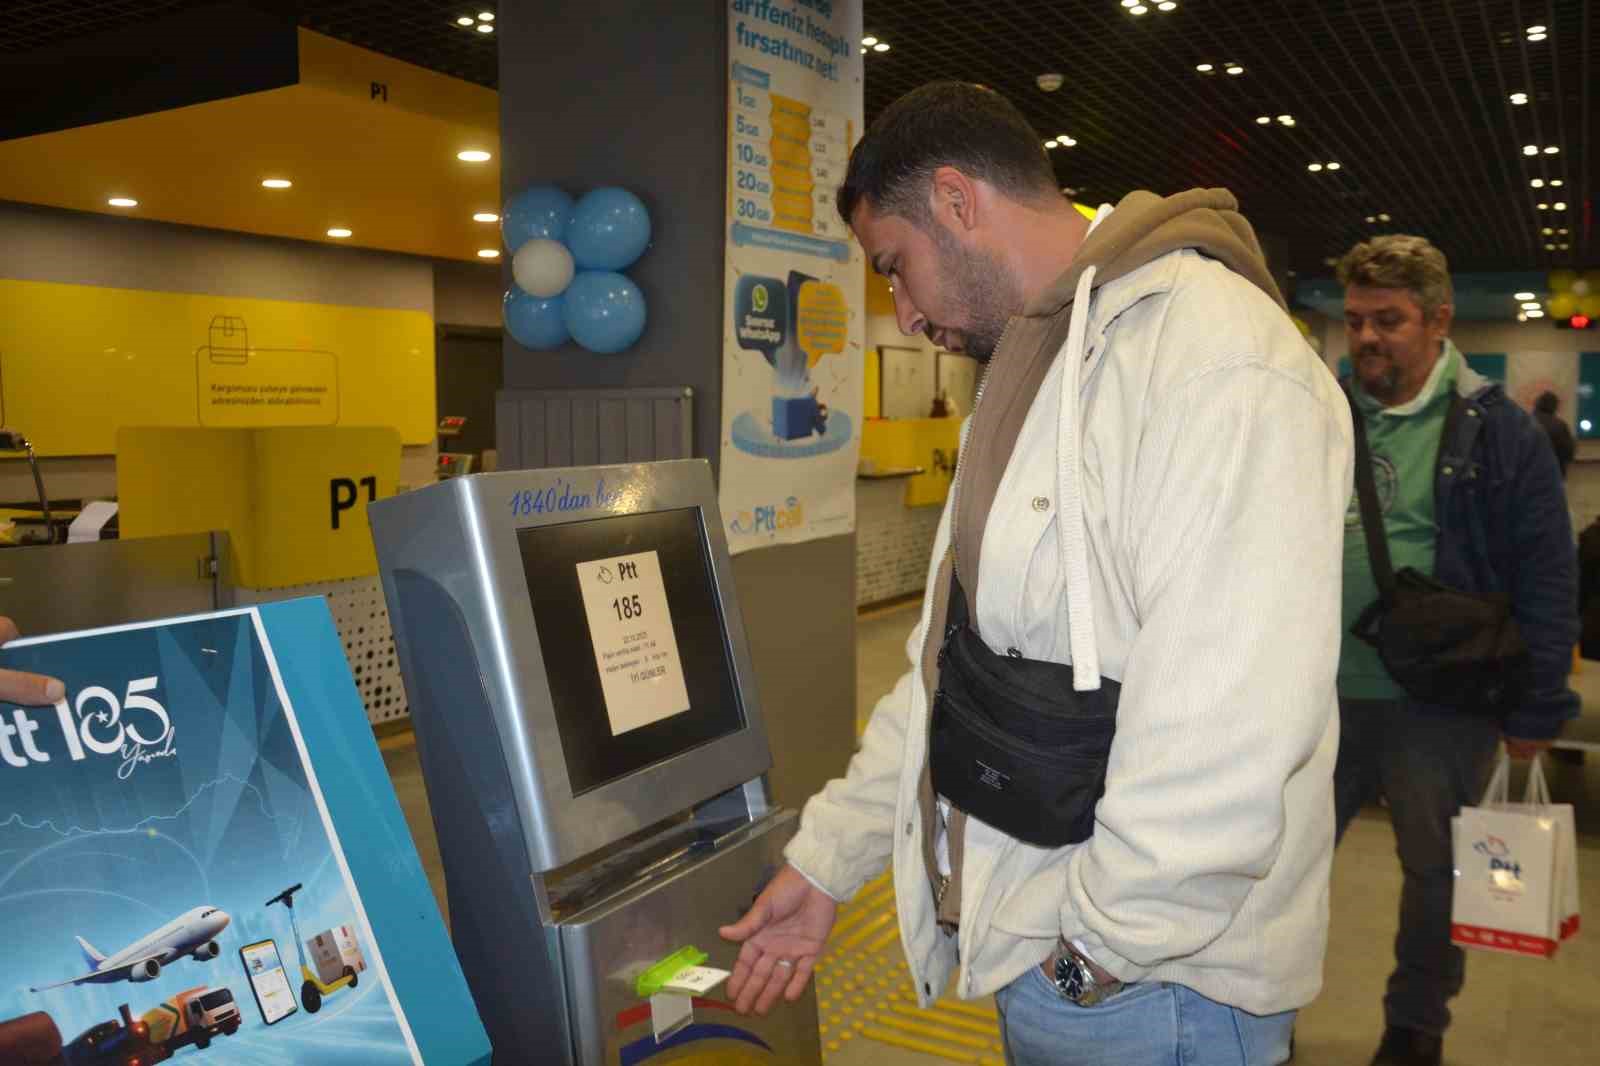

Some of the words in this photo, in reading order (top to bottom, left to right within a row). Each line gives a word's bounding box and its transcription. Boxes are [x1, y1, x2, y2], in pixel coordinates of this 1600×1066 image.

[369, 81, 388, 103] P1
[330, 476, 377, 530] P1
[618, 561, 639, 581] Ptt
[612, 594, 642, 621] 185
